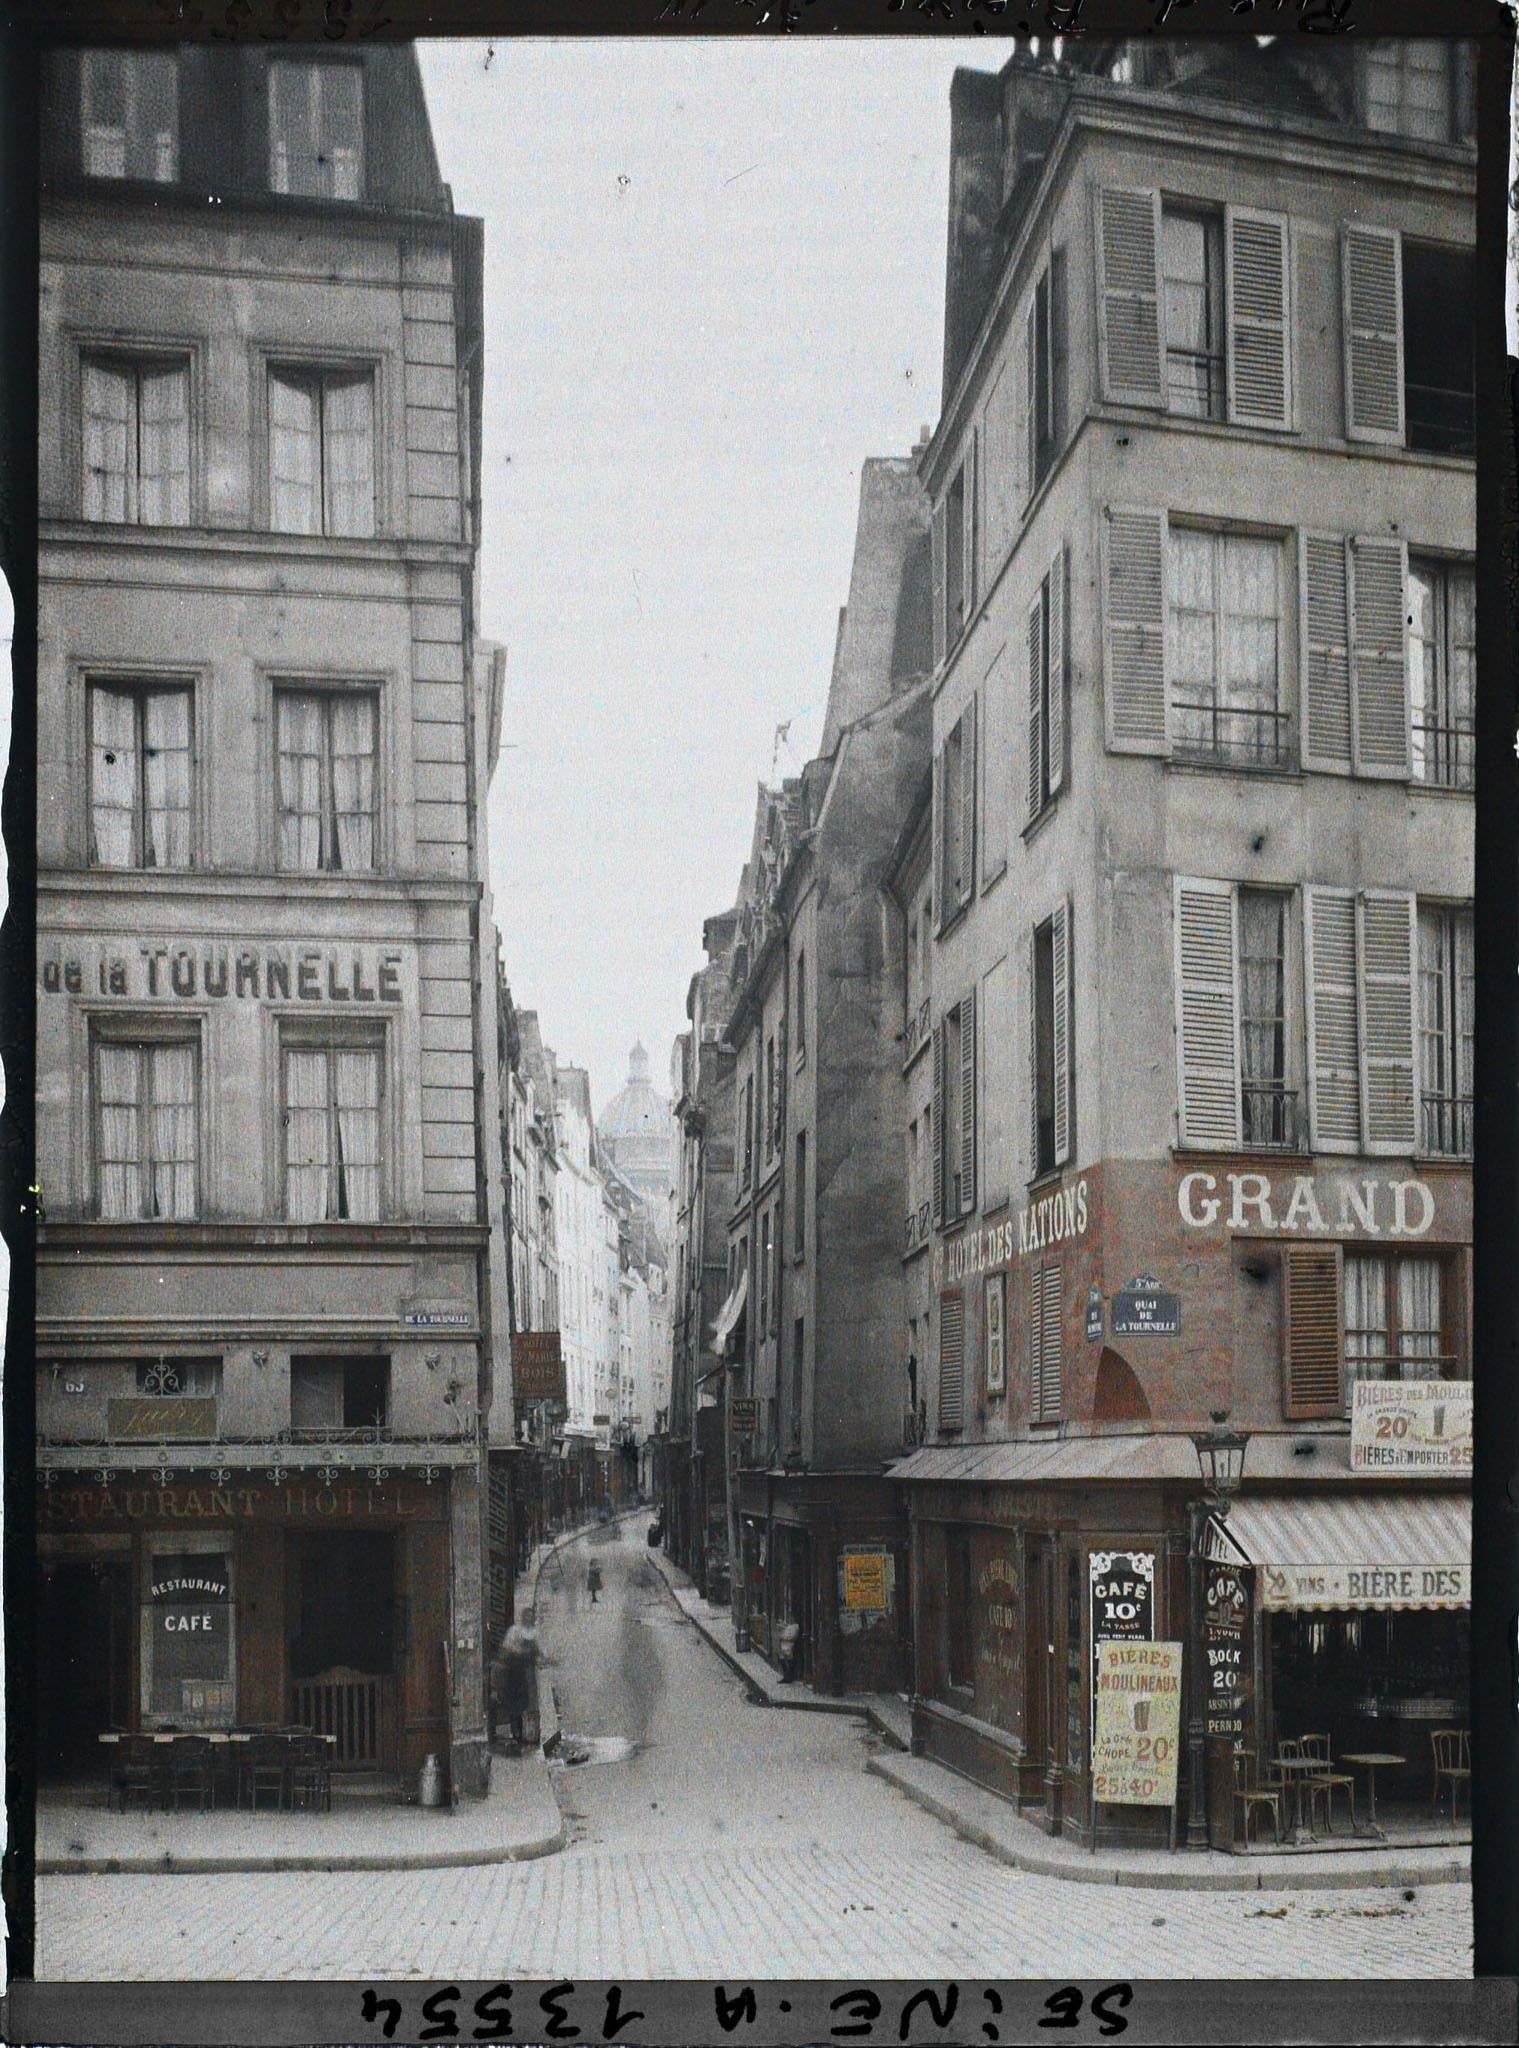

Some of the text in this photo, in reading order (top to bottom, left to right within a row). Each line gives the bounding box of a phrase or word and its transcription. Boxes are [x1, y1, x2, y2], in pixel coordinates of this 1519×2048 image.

[43, 943, 403, 1002] de la TOURNELLE
[1178, 1172, 1435, 1236] GRAND
[988, 1220, 1013, 1268] DES
[1018, 1179, 1088, 1256] NATIONS
[1135, 1299, 1157, 1311] QUAI
[1139, 1311, 1153, 1320] DE
[1115, 1321, 1177, 1331] LA TOURNELLE
[151, 1578, 227, 1597] RESTAURANT
[1421, 1570, 1461, 1597] DES
[164, 1611, 213, 1631] CAFÉ
[1206, 1648, 1242, 1667] BOCK
[1100, 1673, 1180, 1693] MOULINEAUX
[1098, 1745, 1132, 1760] CHOPE
[1095, 1776, 1119, 1796] 25
[358, 1979, 645, 2042] 13554
